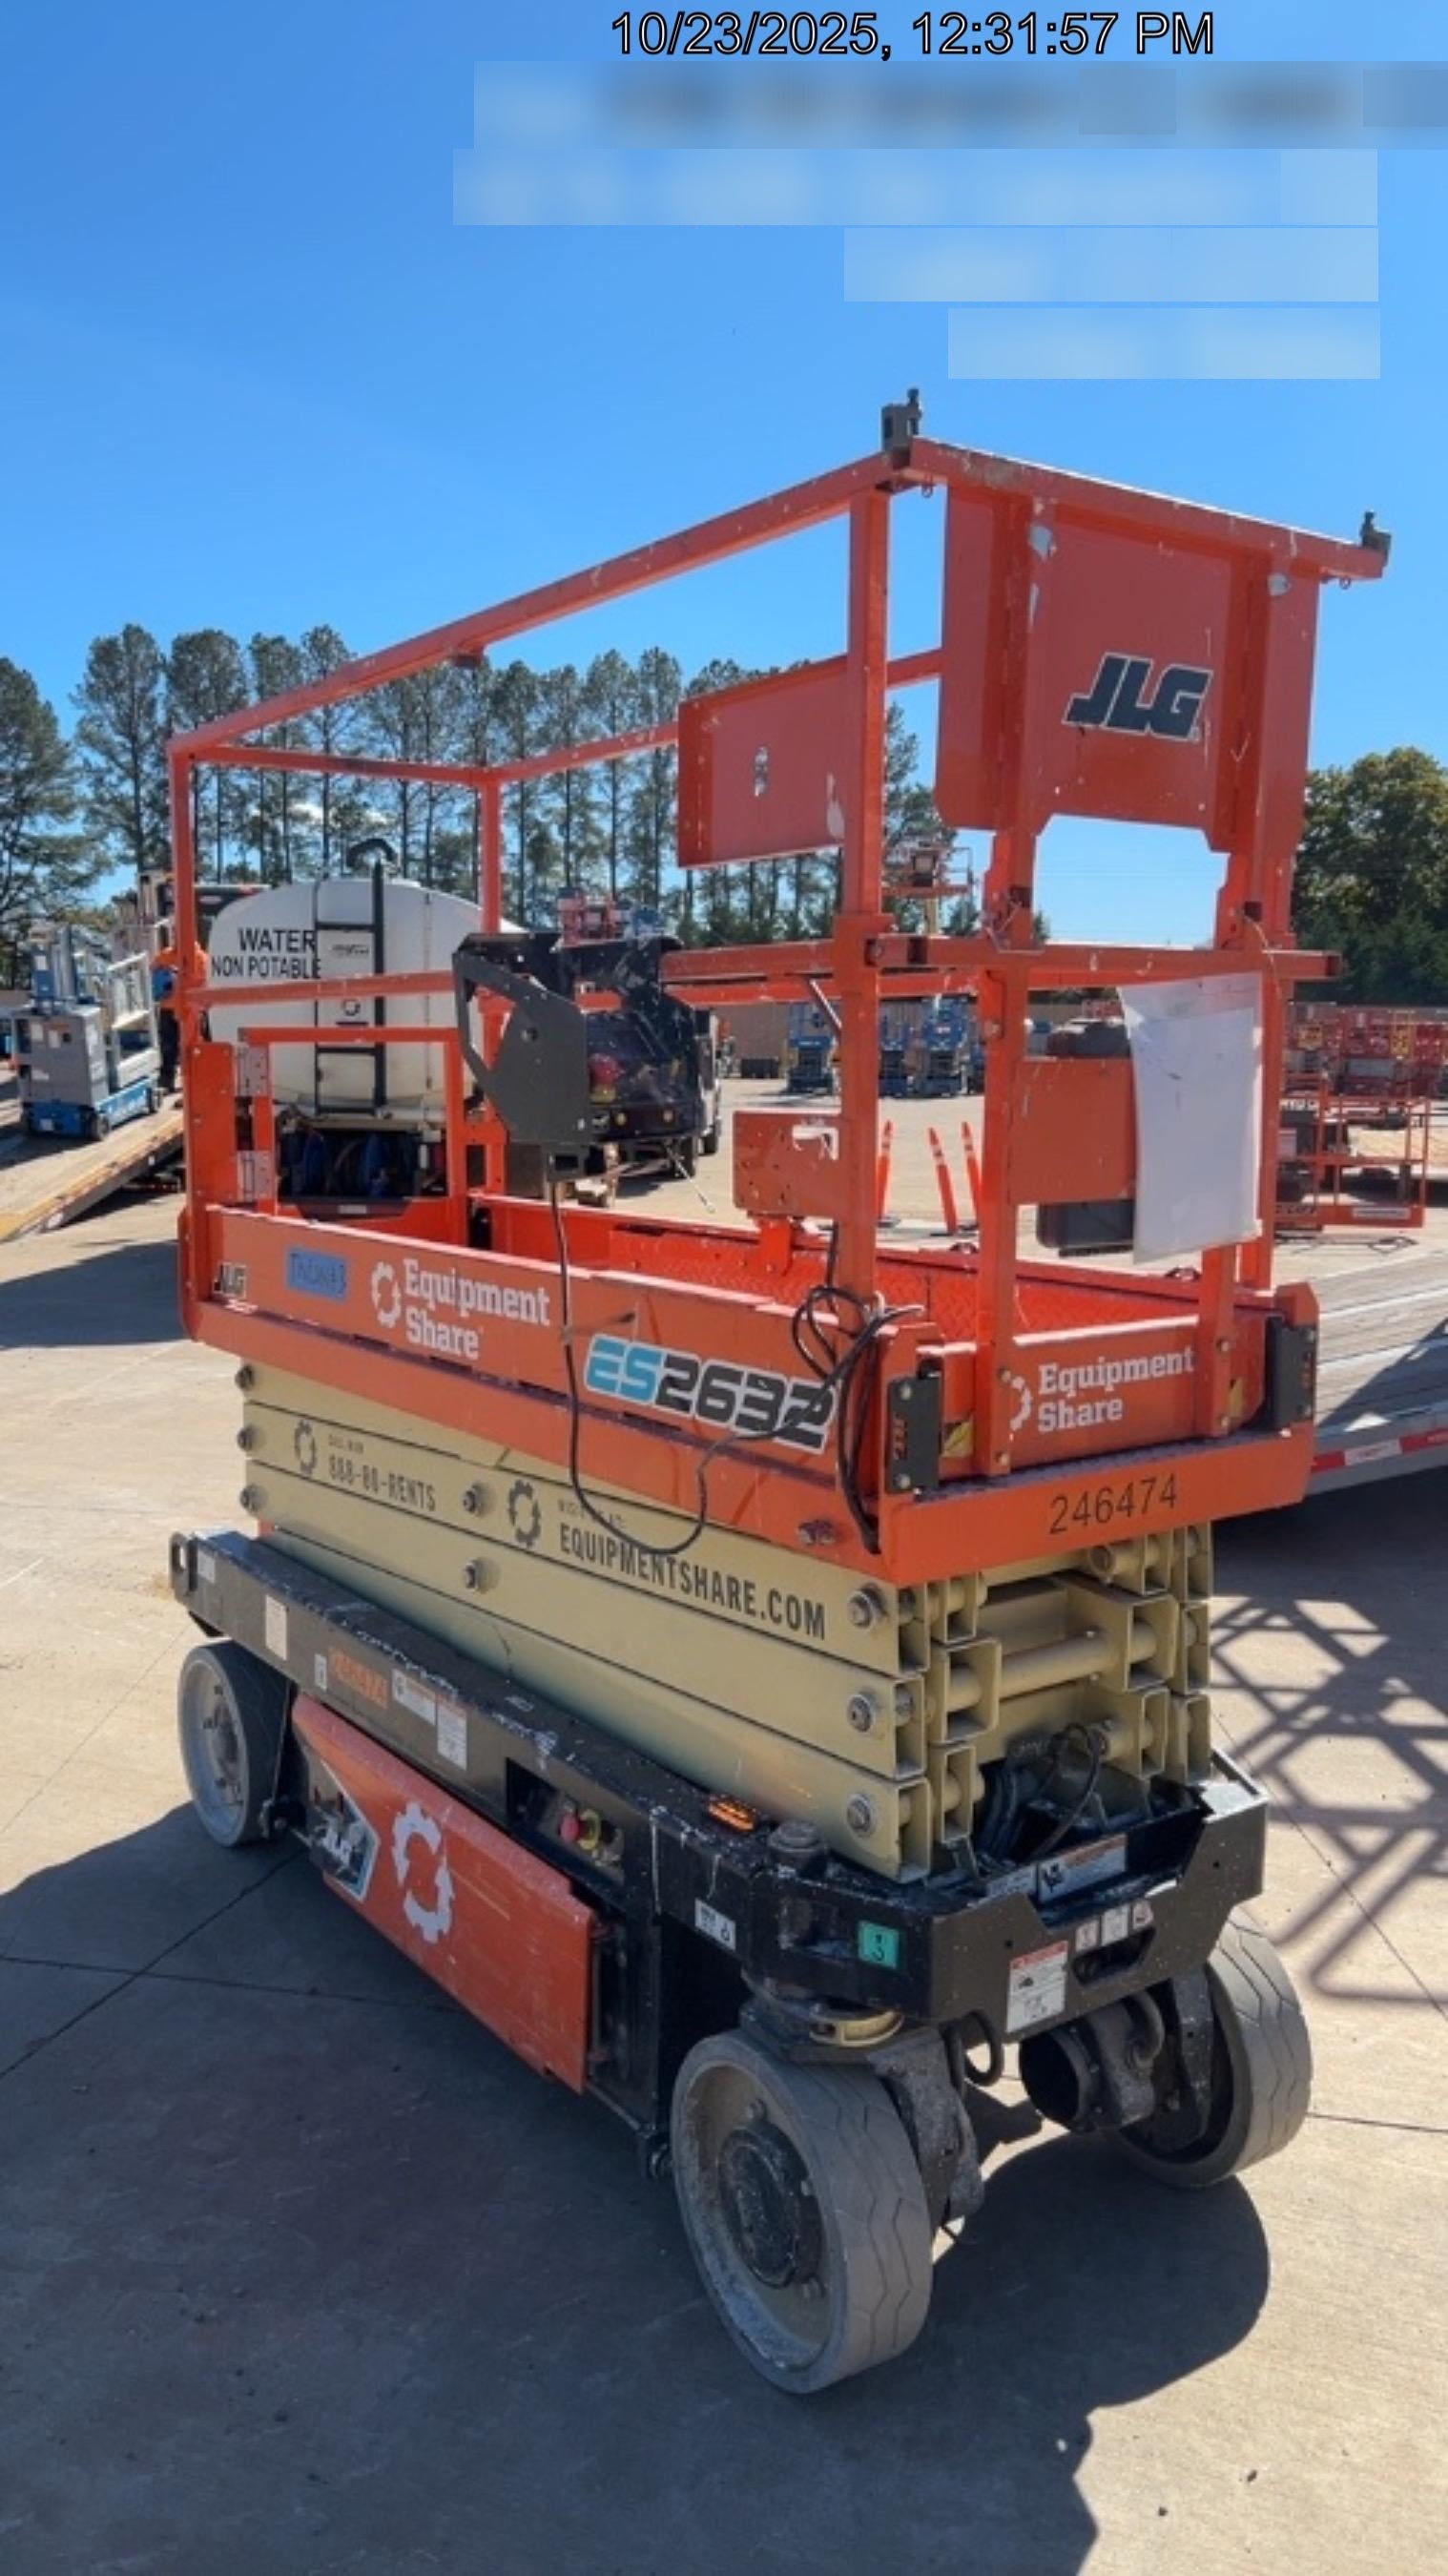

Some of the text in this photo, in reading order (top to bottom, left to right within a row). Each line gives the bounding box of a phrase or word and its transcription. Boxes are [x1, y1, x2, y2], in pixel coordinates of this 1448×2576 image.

[1061, 652, 1214, 741] JLG
[211, 956, 321, 980] NON POTABLE
[238, 928, 316, 953] WATER
[403, 1257, 550, 1326] Equipment
[406, 1305, 480, 1360] Share
[585, 1335, 837, 1452] ES2632
[1038, 1345, 1195, 1397] Equipment
[1038, 1398, 1124, 1434] Share
[1049, 1473, 1177, 1535] 246474
[560, 1522, 826, 1641] EQUIPMENTSHARE.COM
